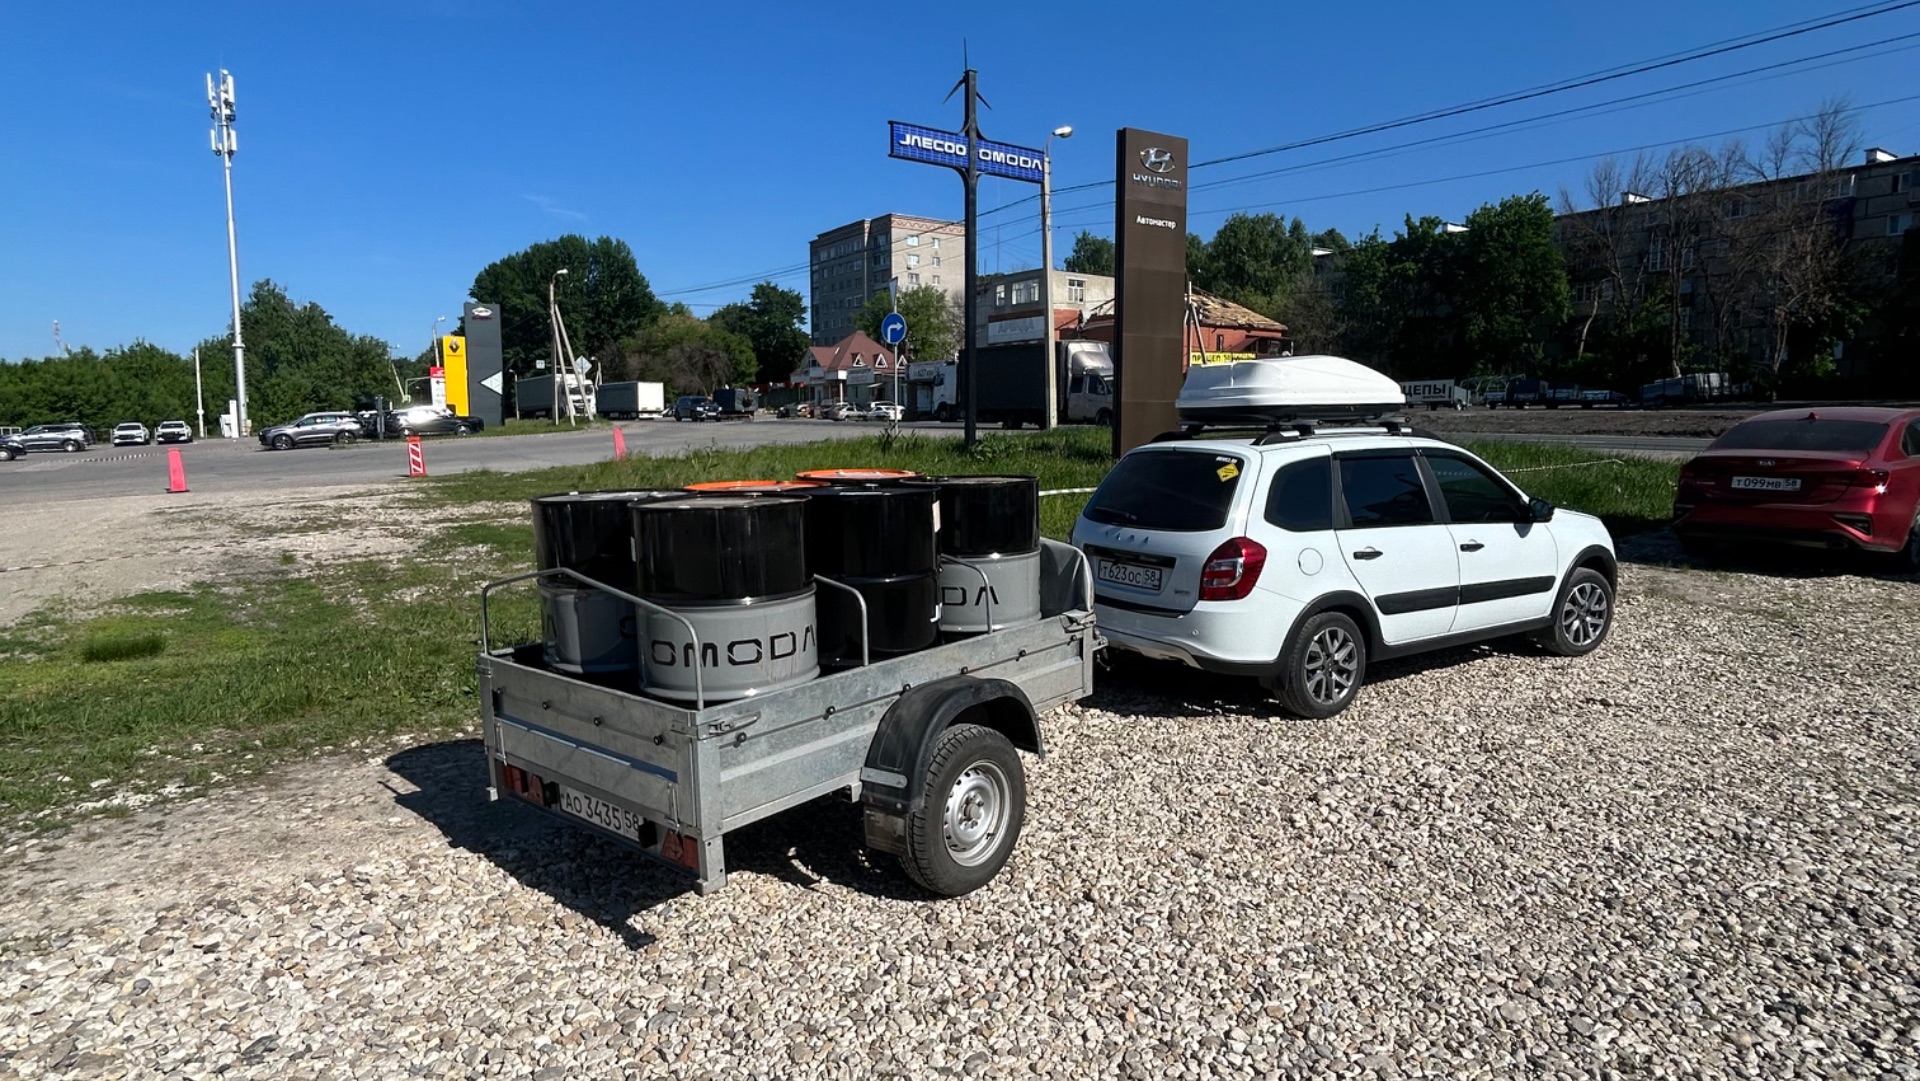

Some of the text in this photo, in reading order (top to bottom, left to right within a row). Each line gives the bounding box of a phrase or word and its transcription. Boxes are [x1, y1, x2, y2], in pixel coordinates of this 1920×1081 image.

[899, 133, 967, 156] JAECOO
[978, 148, 1043, 171] OMODA
[1132, 173, 1182, 192] HYUNDAI
[1136, 215, 1177, 230] Автомастер
[1191, 354, 1221, 363] ПРЦЕП
[1401, 383, 1447, 398] ЦЕПЫ
[1144, 569, 1157, 581] 58
[651, 623, 816, 668] OMODA
